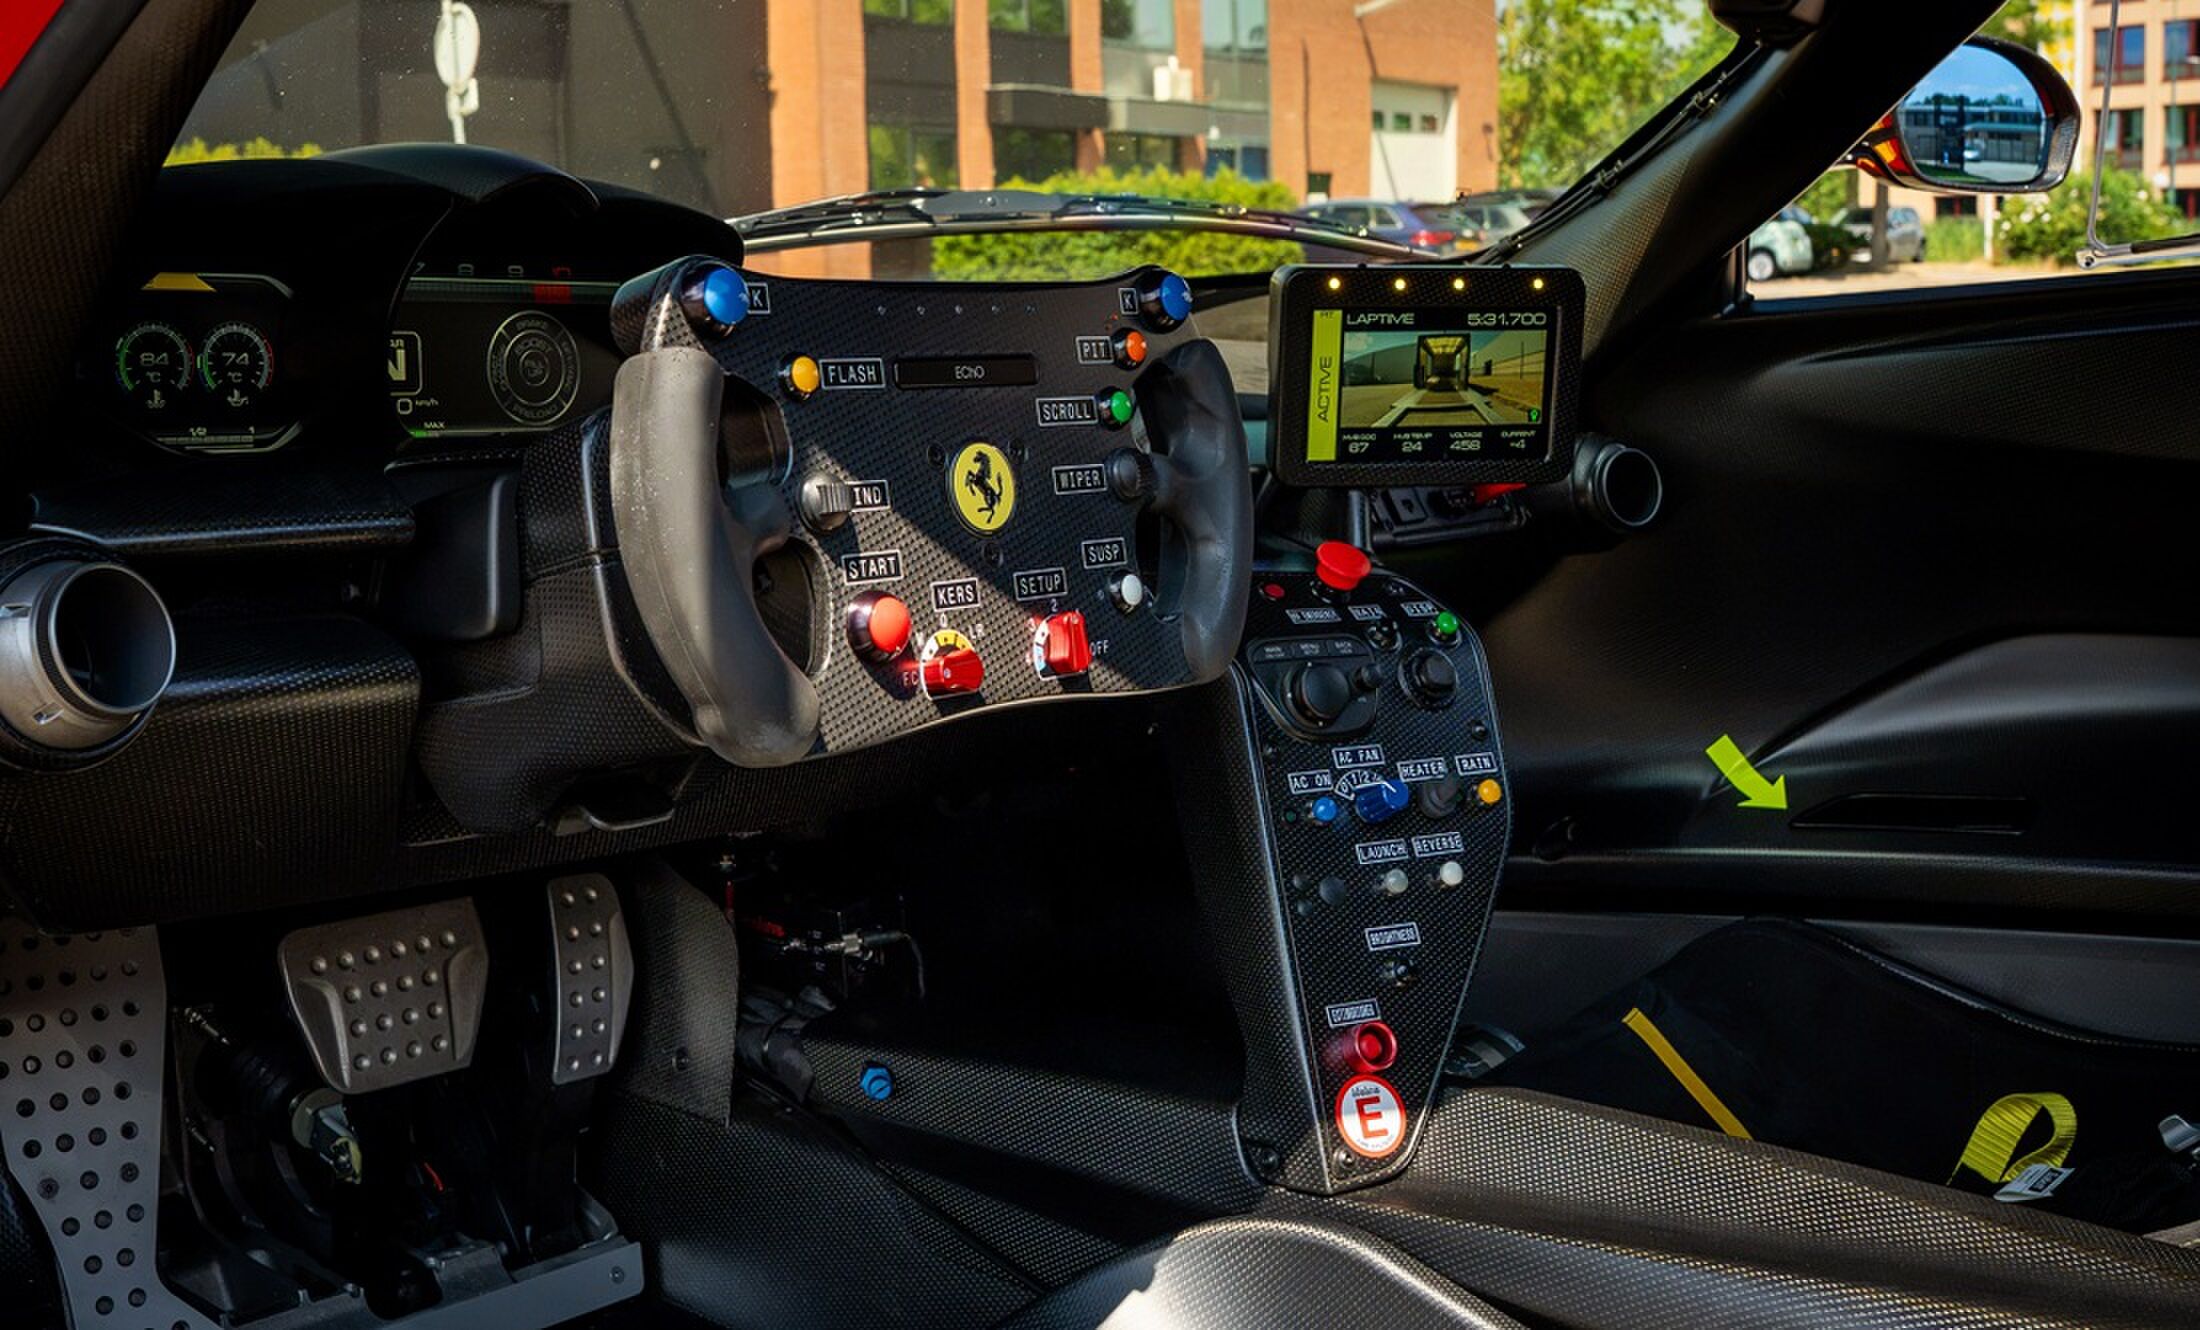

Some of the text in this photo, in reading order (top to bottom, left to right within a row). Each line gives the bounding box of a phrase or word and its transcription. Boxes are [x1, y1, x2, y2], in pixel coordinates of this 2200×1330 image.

[753, 289, 764, 307] K
[1123, 293, 1134, 310] K
[1346, 313, 1415, 325] LAPTIME
[1467, 312, 1548, 326] 5:31.700
[139, 352, 170, 366] 84
[221, 352, 250, 366] 74
[1082, 342, 1106, 359] PIT
[827, 364, 877, 384] FLASH
[1317, 356, 1333, 424] ACTIVE
[1042, 401, 1091, 421] SCROLL
[424, 421, 446, 429] MAX
[1058, 469, 1102, 489] WIPER
[852, 486, 882, 505] IND
[1088, 543, 1120, 563] SUSP
[849, 557, 897, 579] START
[1019, 574, 1062, 595] SETUP
[936, 584, 975, 606] KERS
[1050, 598, 1059, 612] 2
[968, 623, 985, 639] LR
[1089, 639, 1109, 656] OFF
[1338, 749, 1380, 764] AC FAN
[1461, 757, 1491, 770] RAIN
[1362, 772, 1370, 783] 2
[1402, 761, 1447, 778] HEATER
[1293, 774, 1332, 789] AC ON
[1351, 773, 1358, 784] 1
[1359, 842, 1407, 860] LAUNCH
[1415, 836, 1462, 853] REVERSE
[1356, 1095, 1389, 1140] E
